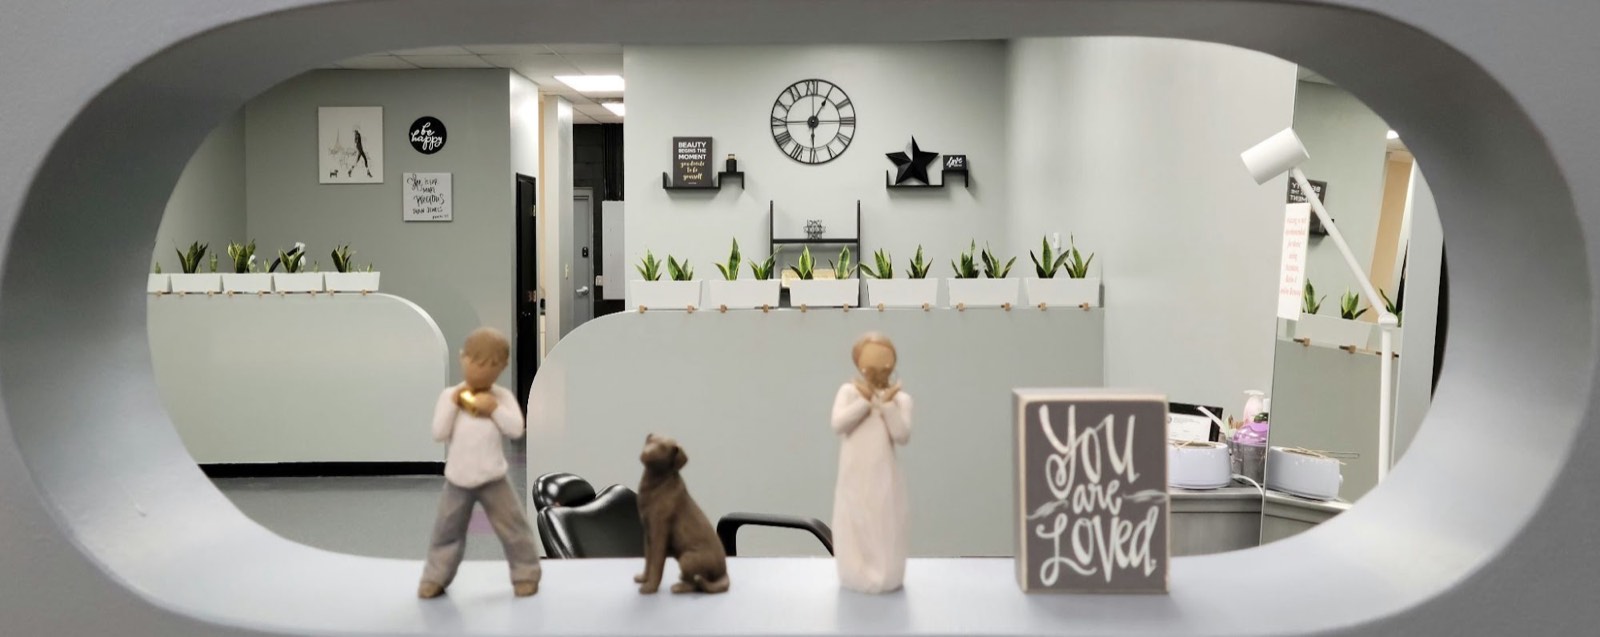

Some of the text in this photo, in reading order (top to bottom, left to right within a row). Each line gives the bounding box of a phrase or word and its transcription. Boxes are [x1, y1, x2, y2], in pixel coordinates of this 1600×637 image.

[421, 122, 435, 136] be
[411, 129, 443, 151] happy
[678, 141, 707, 149] BEAUTY
[1073, 479, 1123, 515] are
